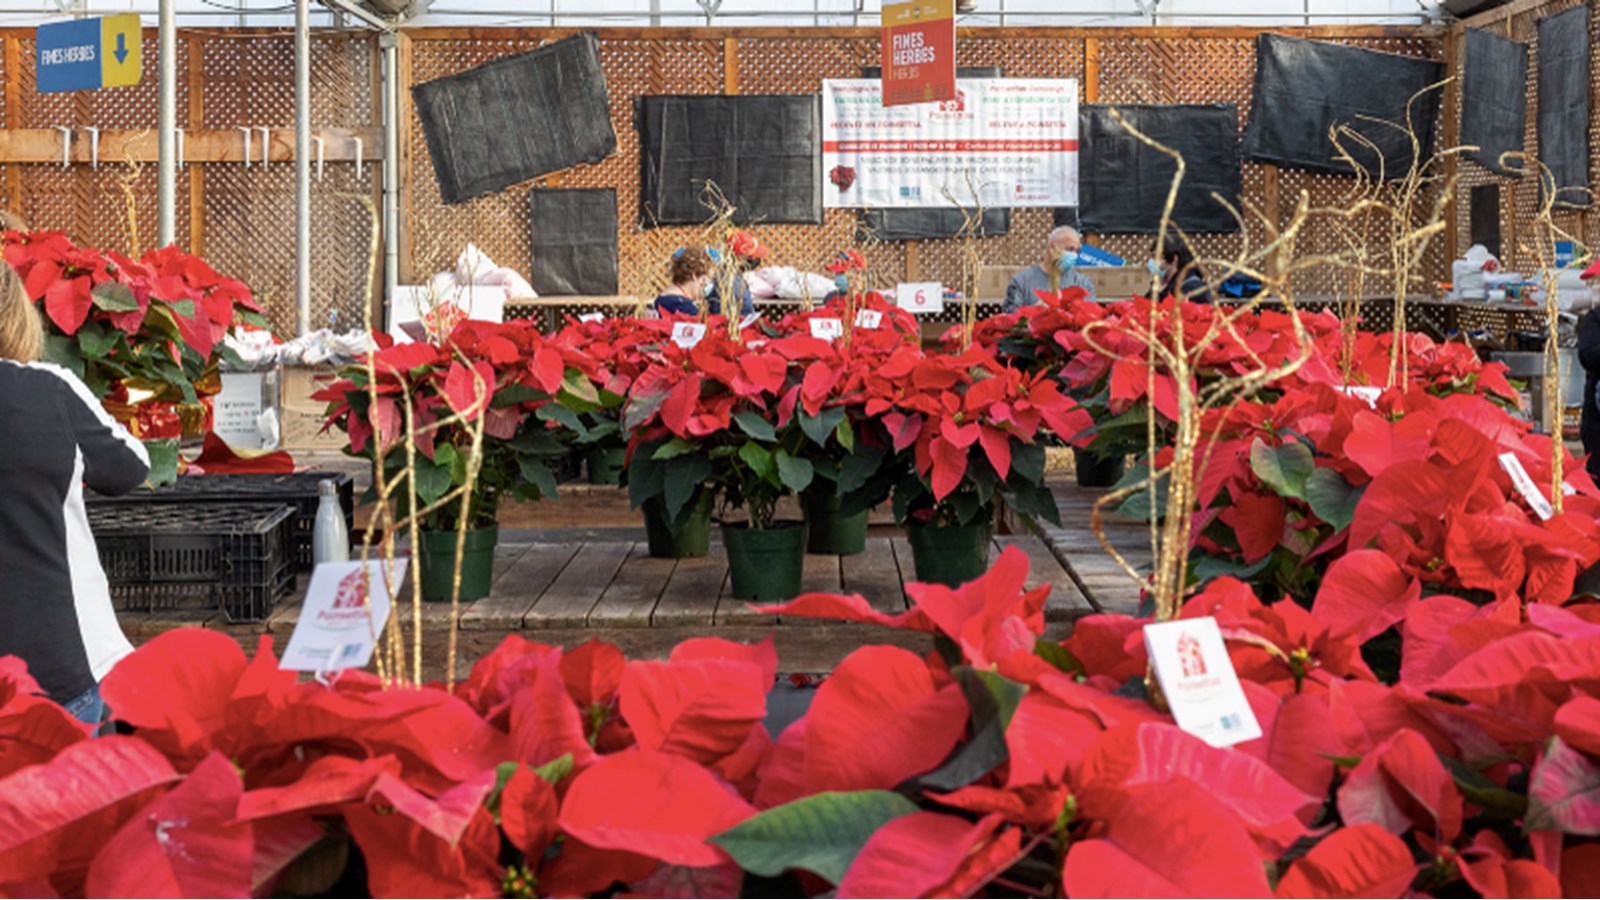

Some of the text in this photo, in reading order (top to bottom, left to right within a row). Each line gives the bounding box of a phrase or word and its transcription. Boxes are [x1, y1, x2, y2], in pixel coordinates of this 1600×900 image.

[893, 32, 924, 49] FINES
[41, 48, 63, 65] FINES
[893, 46, 935, 66] HERBES
[914, 289, 926, 305] 6
